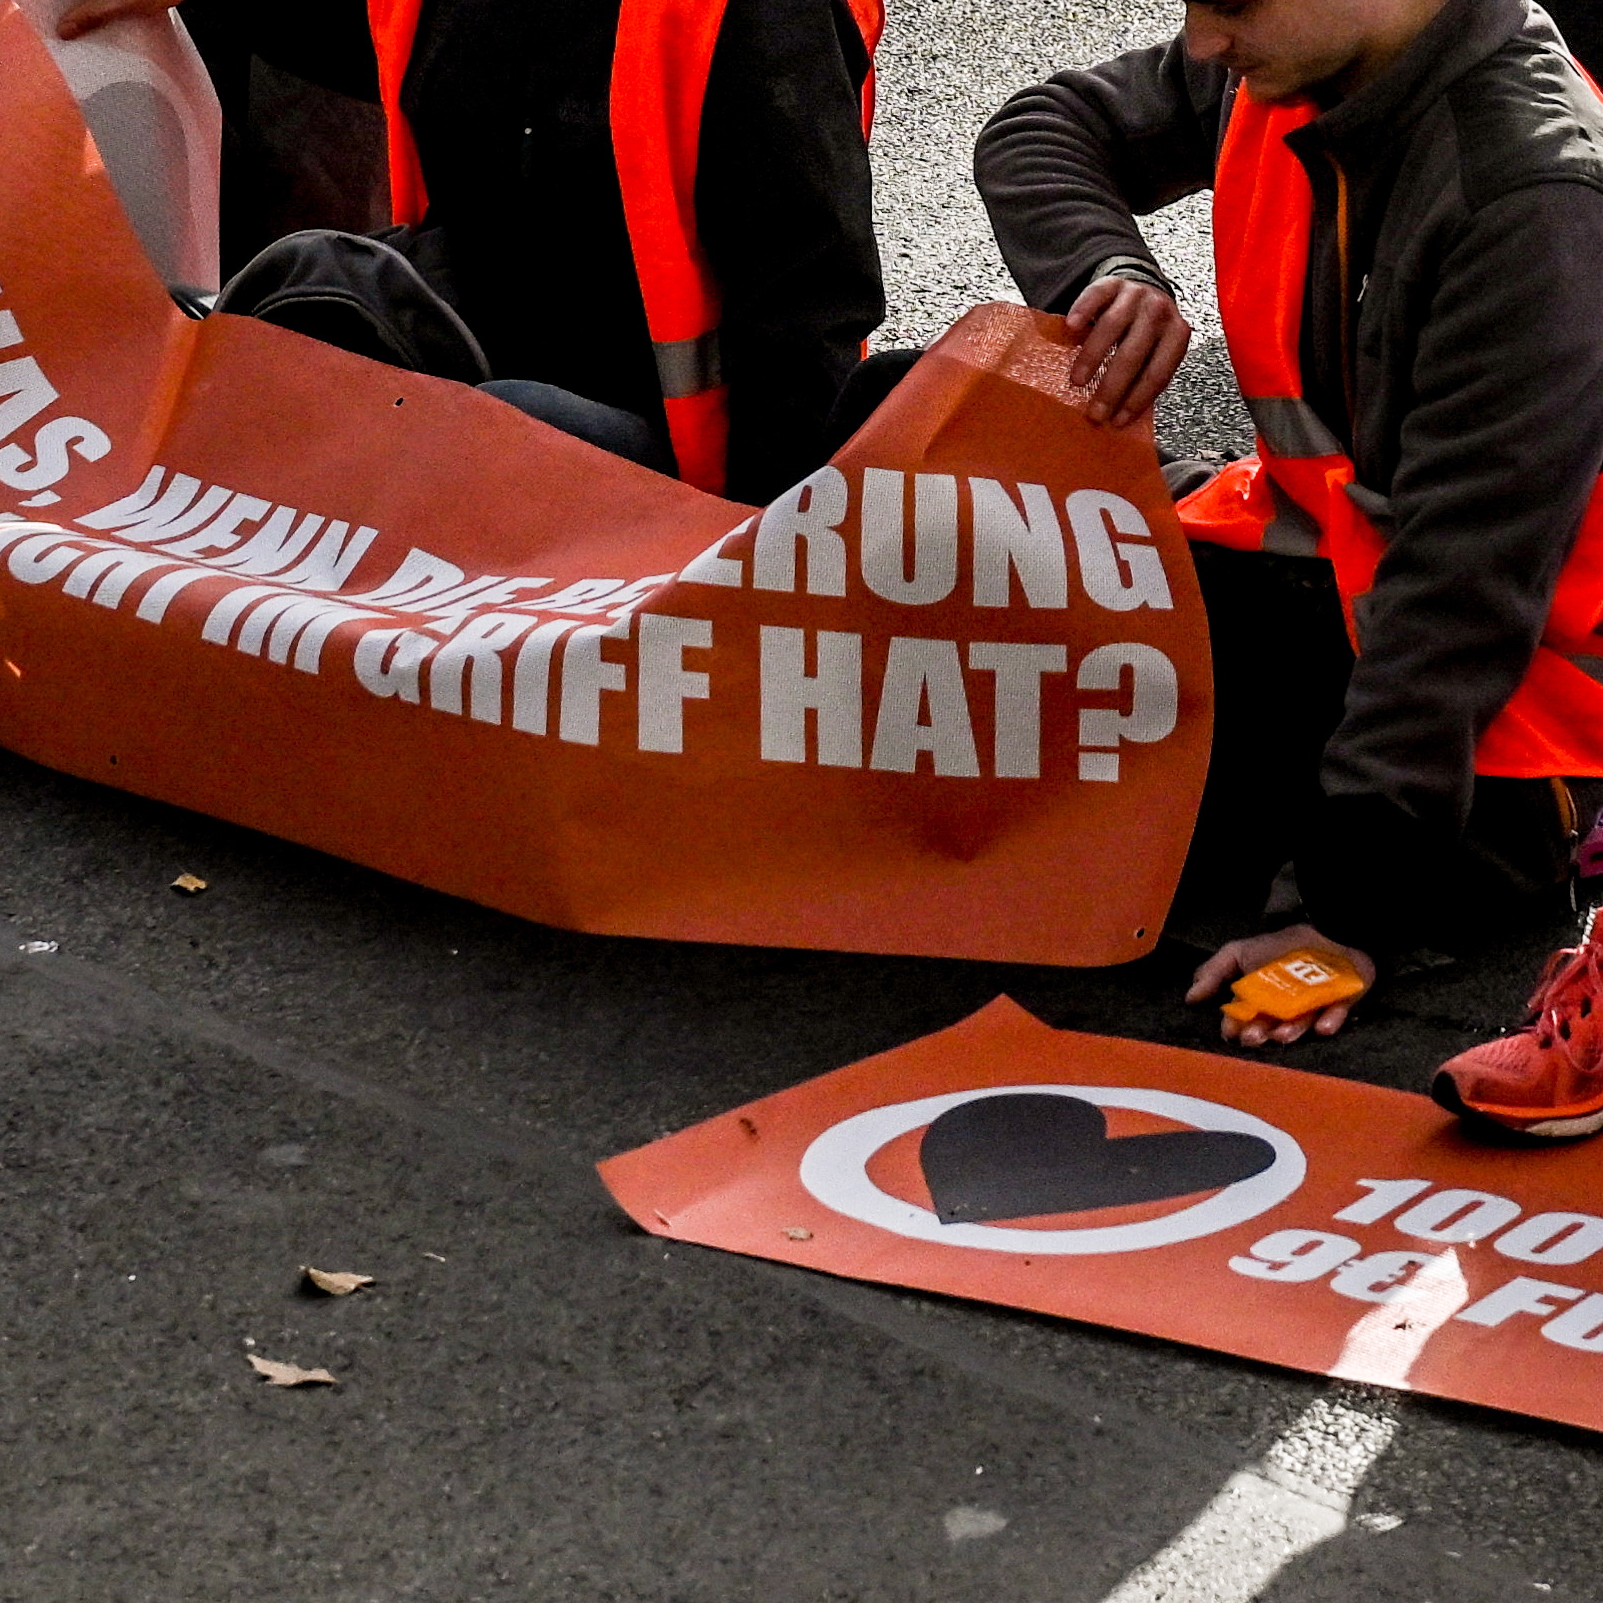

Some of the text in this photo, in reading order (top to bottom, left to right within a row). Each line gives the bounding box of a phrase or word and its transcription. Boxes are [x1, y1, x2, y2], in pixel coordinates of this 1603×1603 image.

[73, 464, 379, 592] WENN
[354, 612, 713, 754] GRIFF
[760, 624, 1178, 783] HAT?
[1228, 1229, 1448, 1304] 9€
